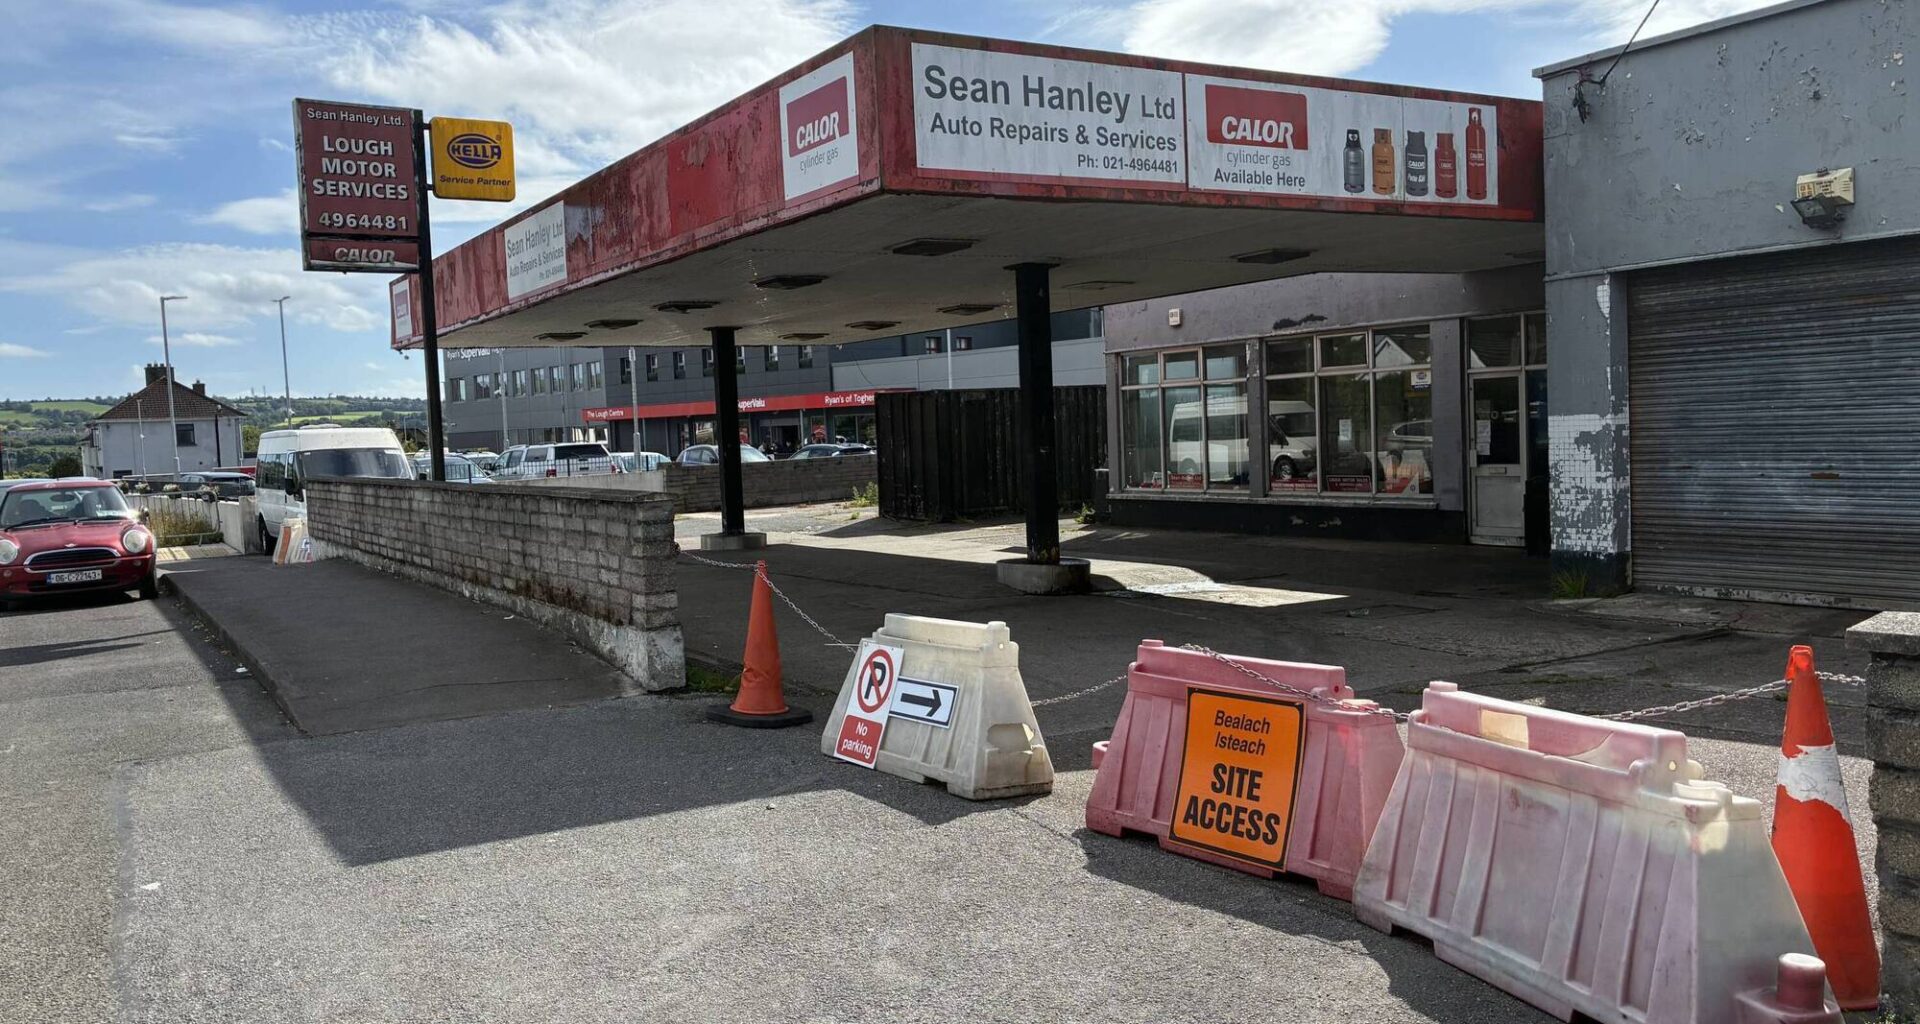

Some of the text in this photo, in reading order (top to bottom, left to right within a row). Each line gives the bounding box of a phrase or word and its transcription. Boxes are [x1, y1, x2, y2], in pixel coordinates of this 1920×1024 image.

[924, 64, 1176, 124] Sean Hanley Ltd
[306, 108, 405, 127] Sean Hanley Ltd.
[796, 111, 840, 151] CALOR
[930, 112, 1178, 152] Auto Repairs & Services
[1221, 115, 1295, 151] CALOR
[322, 135, 394, 157] LOUGH
[449, 142, 502, 160] HELLA
[321, 157, 398, 179] MOTOR
[799, 147, 840, 176] cylinder gas
[1077, 153, 1179, 174] Ph: 021-4964481
[1226, 149, 1292, 168] cylinder gas
[439, 174, 512, 188] Service Partner
[1213, 167, 1306, 188] Available Here
[312, 178, 408, 200] SERVICES
[318, 212, 409, 231] 4964481
[506, 219, 563, 258] Sean Hanley Ltd
[334, 246, 397, 265] CALOR
[519, 255, 538, 275] Repairs
[543, 247, 564, 264] Services
[824, 395, 845, 406] Ryan's
[845, 394, 853, 403] of
[595, 409, 609, 419] Lough
[609, 408, 624, 417] Centre
[855, 721, 868, 736] No
[1213, 709, 1271, 735] Bealach
[840, 736, 873, 760] parking
[1214, 731, 1266, 756] Isteach
[1210, 762, 1263, 803] SITE
[1182, 795, 1281, 846] ACCESS
